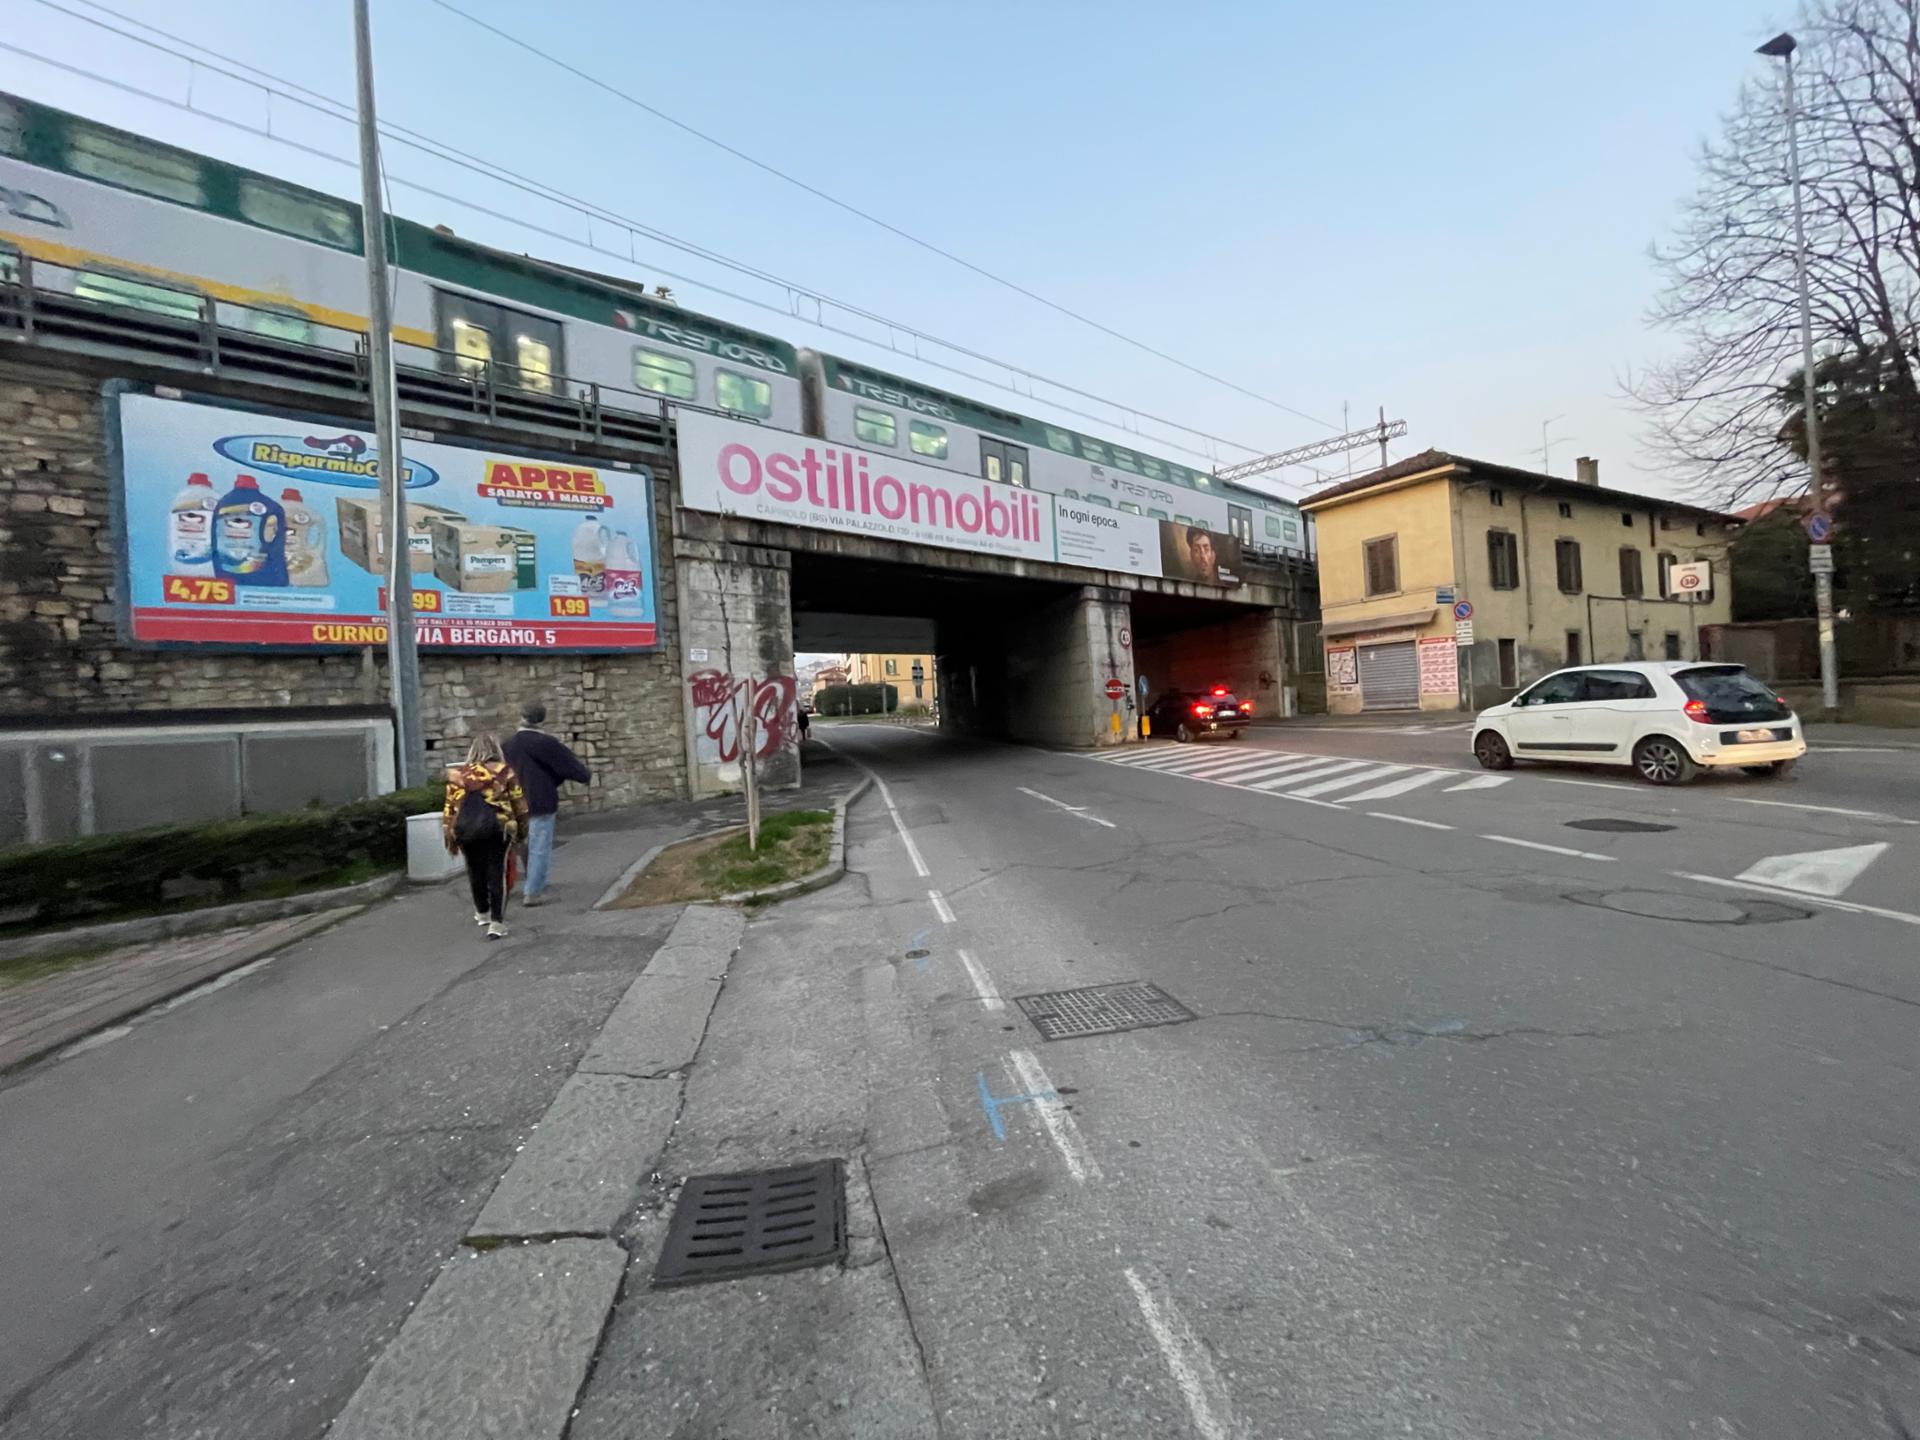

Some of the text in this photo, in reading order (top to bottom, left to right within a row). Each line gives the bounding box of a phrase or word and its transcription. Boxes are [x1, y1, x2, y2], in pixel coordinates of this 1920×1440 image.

[491, 463, 596, 493] APRE
[487, 488, 605, 505] SABATO 1 MARZO
[830, 517, 845, 526] VIA
[1058, 505, 1120, 529] In ogni epoca.
[407, 537, 430, 547] pers
[470, 555, 506, 565] Pampers
[170, 579, 230, 602] 4,75
[581, 575, 604, 590] ACE
[615, 581, 635, 592] ACE
[553, 598, 586, 616] 1,99
[312, 624, 556, 646] CURNO VIA BERGAMO, 5
